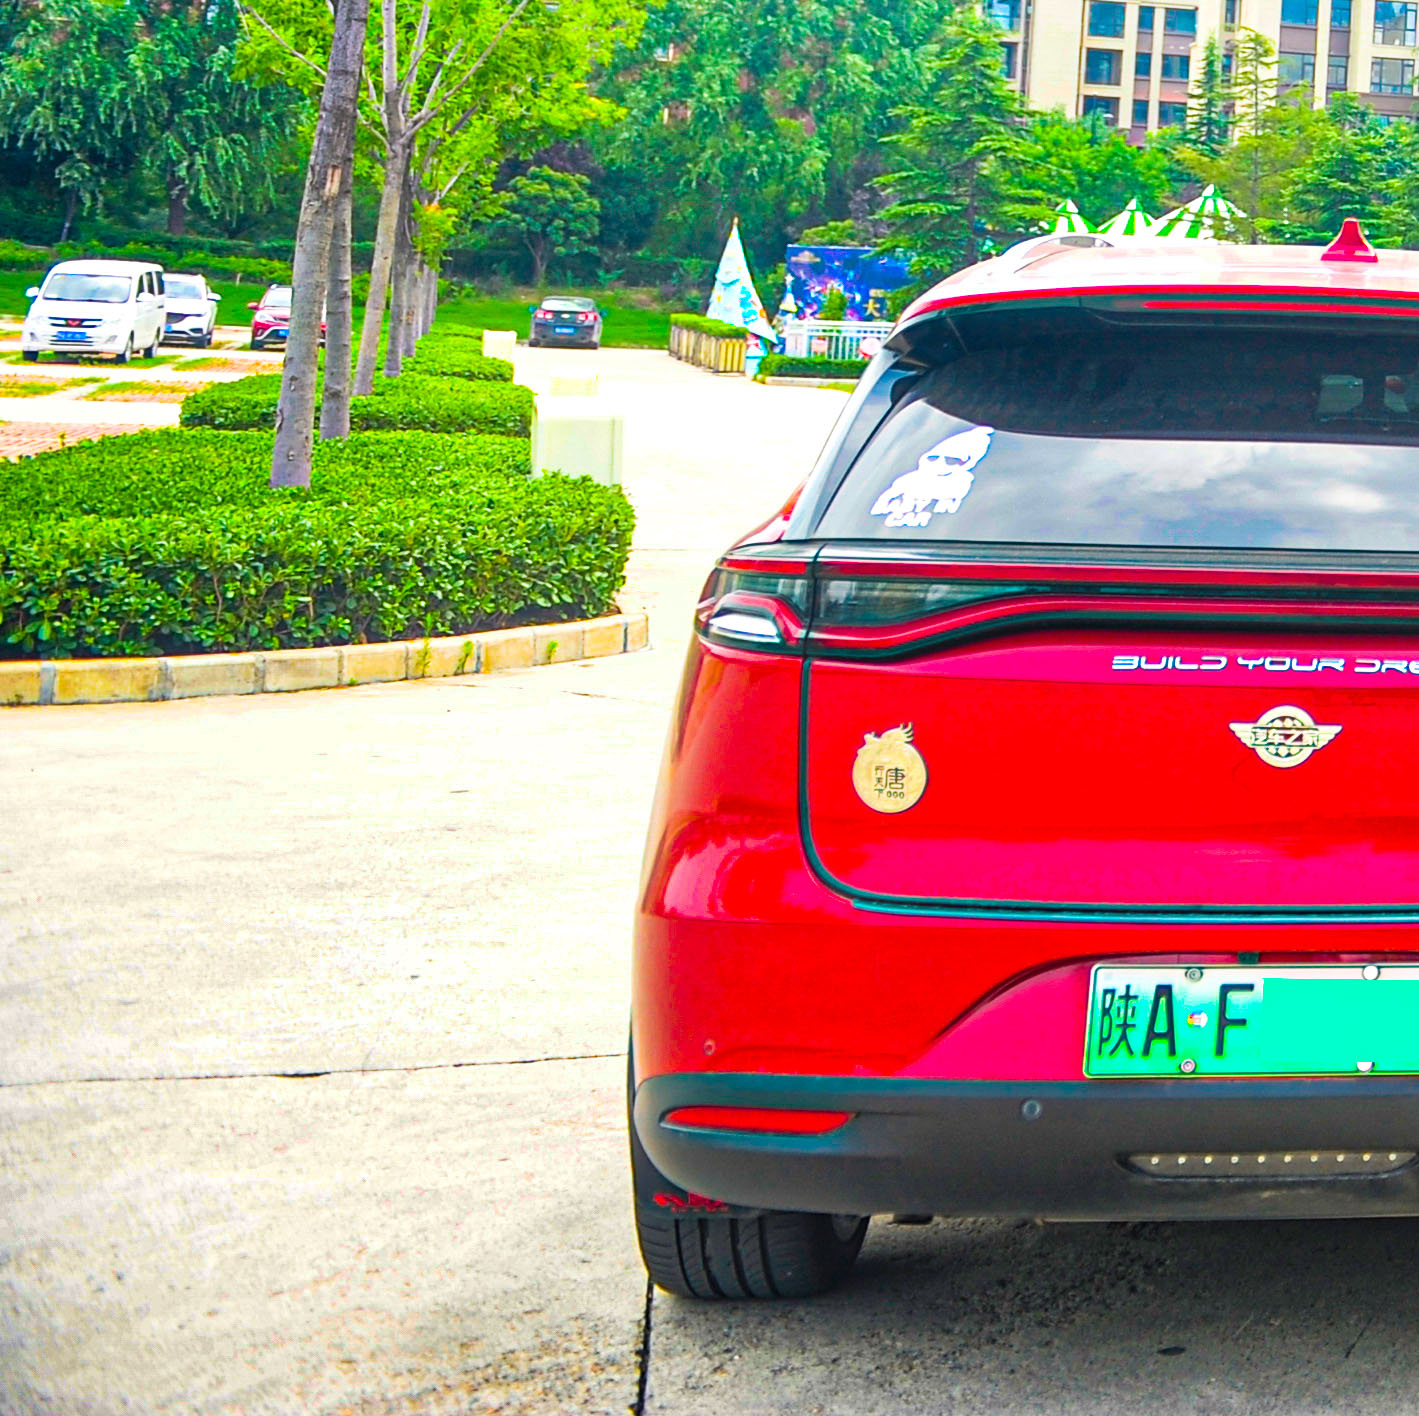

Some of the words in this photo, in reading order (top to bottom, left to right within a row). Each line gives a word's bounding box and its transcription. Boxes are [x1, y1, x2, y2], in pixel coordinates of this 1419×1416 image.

[1112, 655, 1228, 671] BUILD
[1237, 656, 1344, 672] YOUR
[885, 767, 906, 790] 唐
